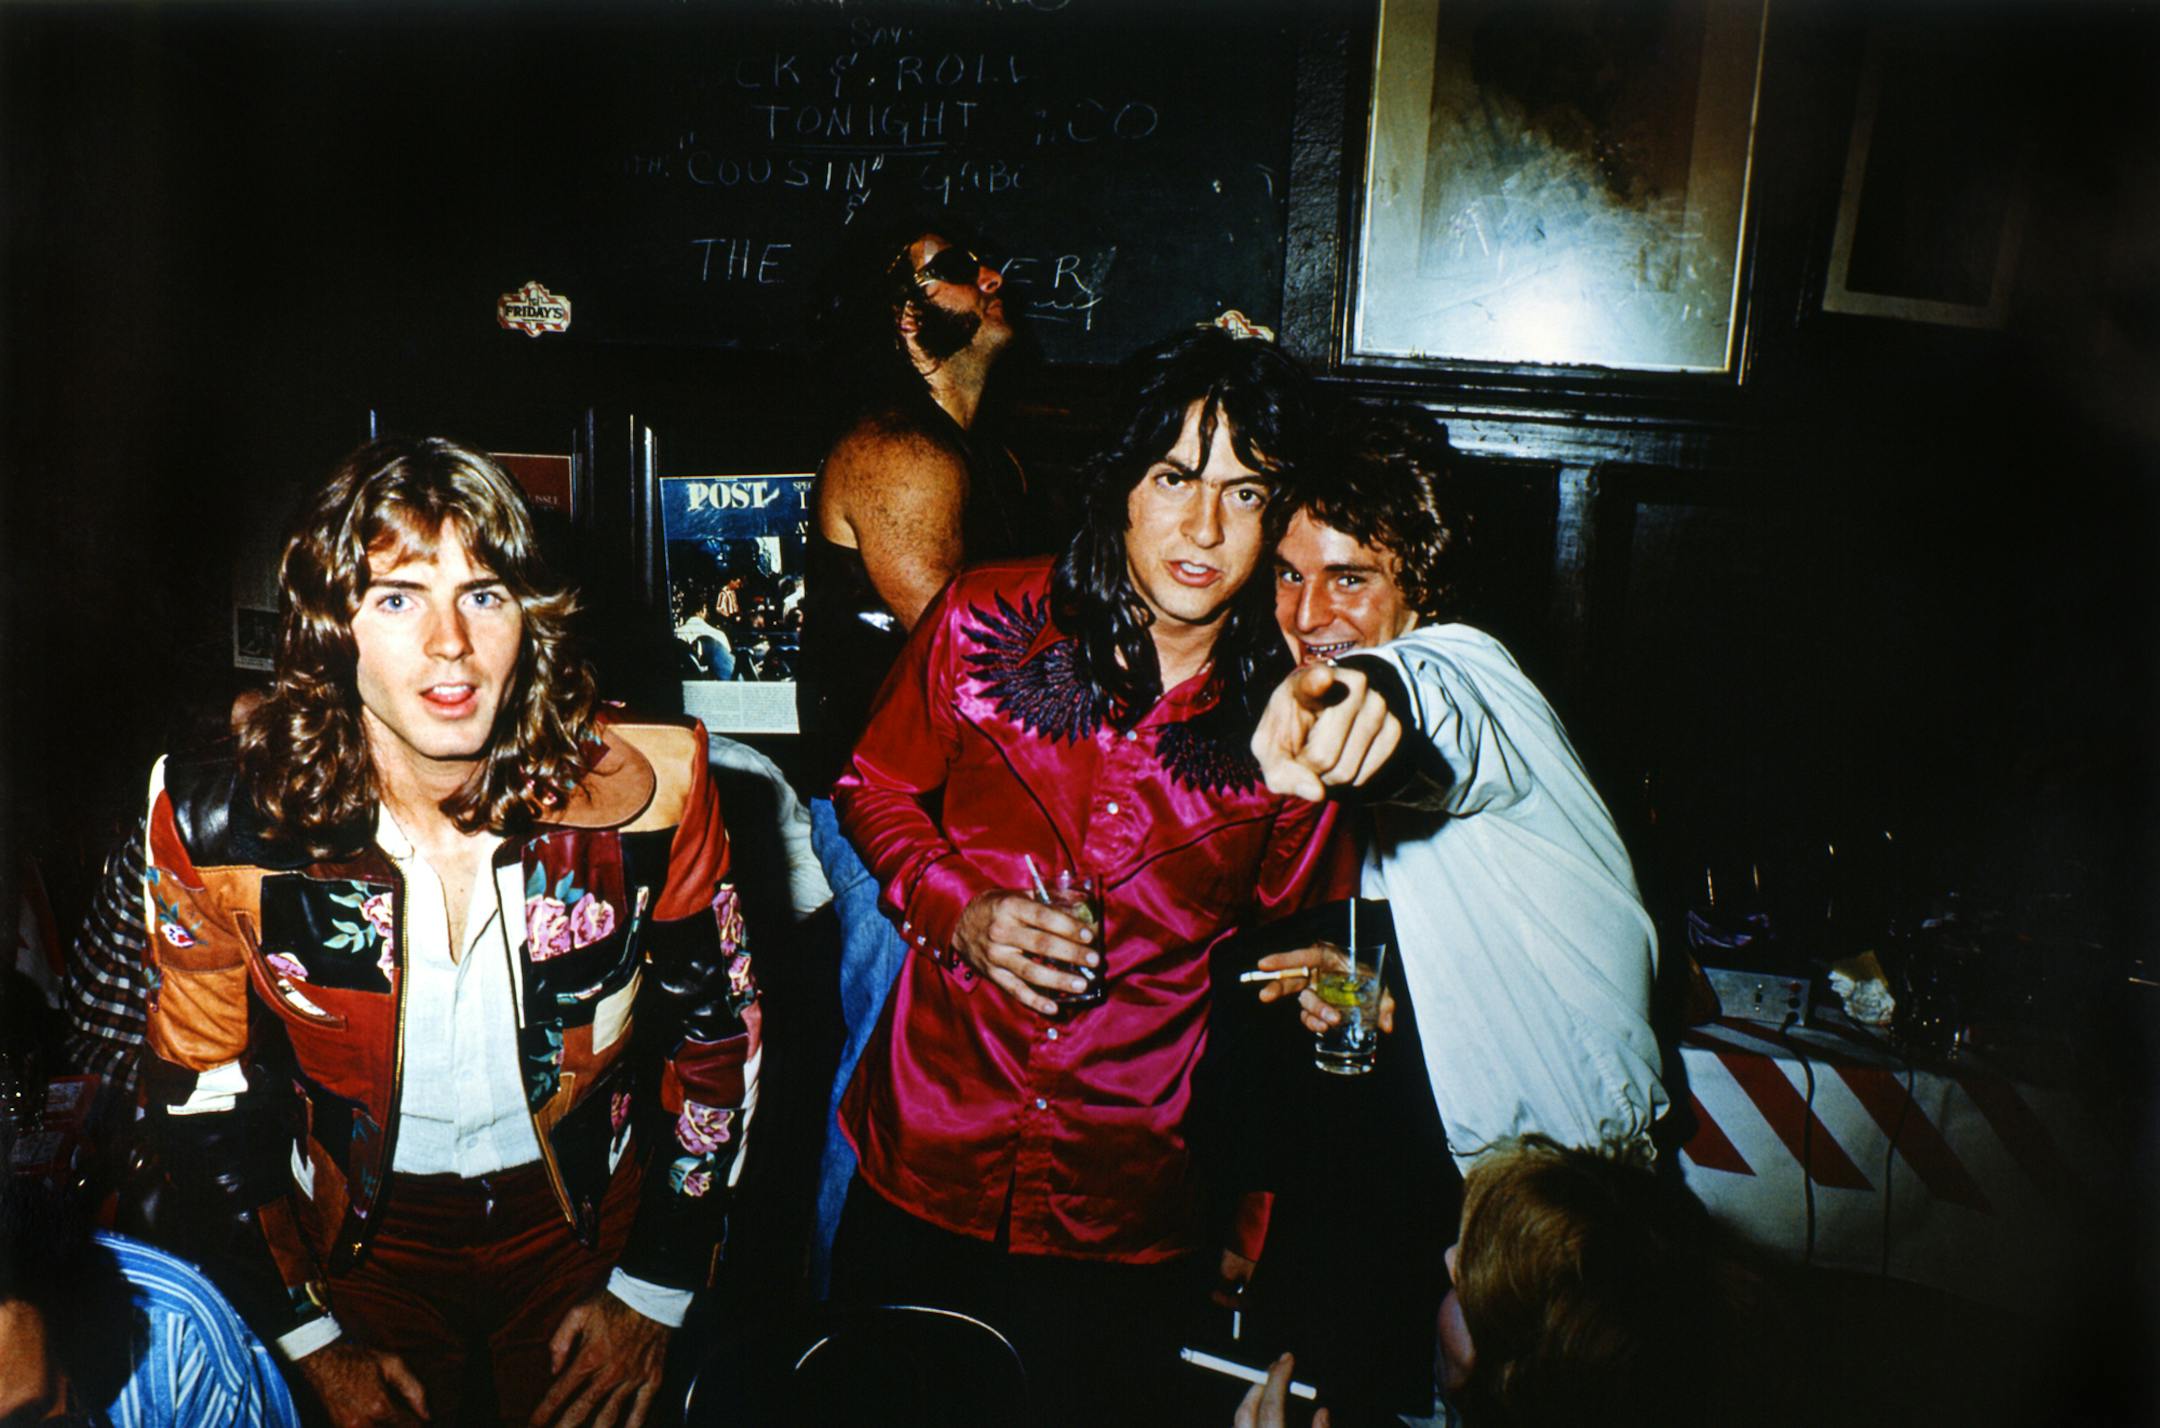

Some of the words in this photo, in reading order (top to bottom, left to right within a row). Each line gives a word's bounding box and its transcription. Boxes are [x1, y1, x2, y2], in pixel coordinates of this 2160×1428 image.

[752, 100, 978, 146] TONIGHT
[689, 238, 792, 285] THE
[687, 482, 779, 511] POST
